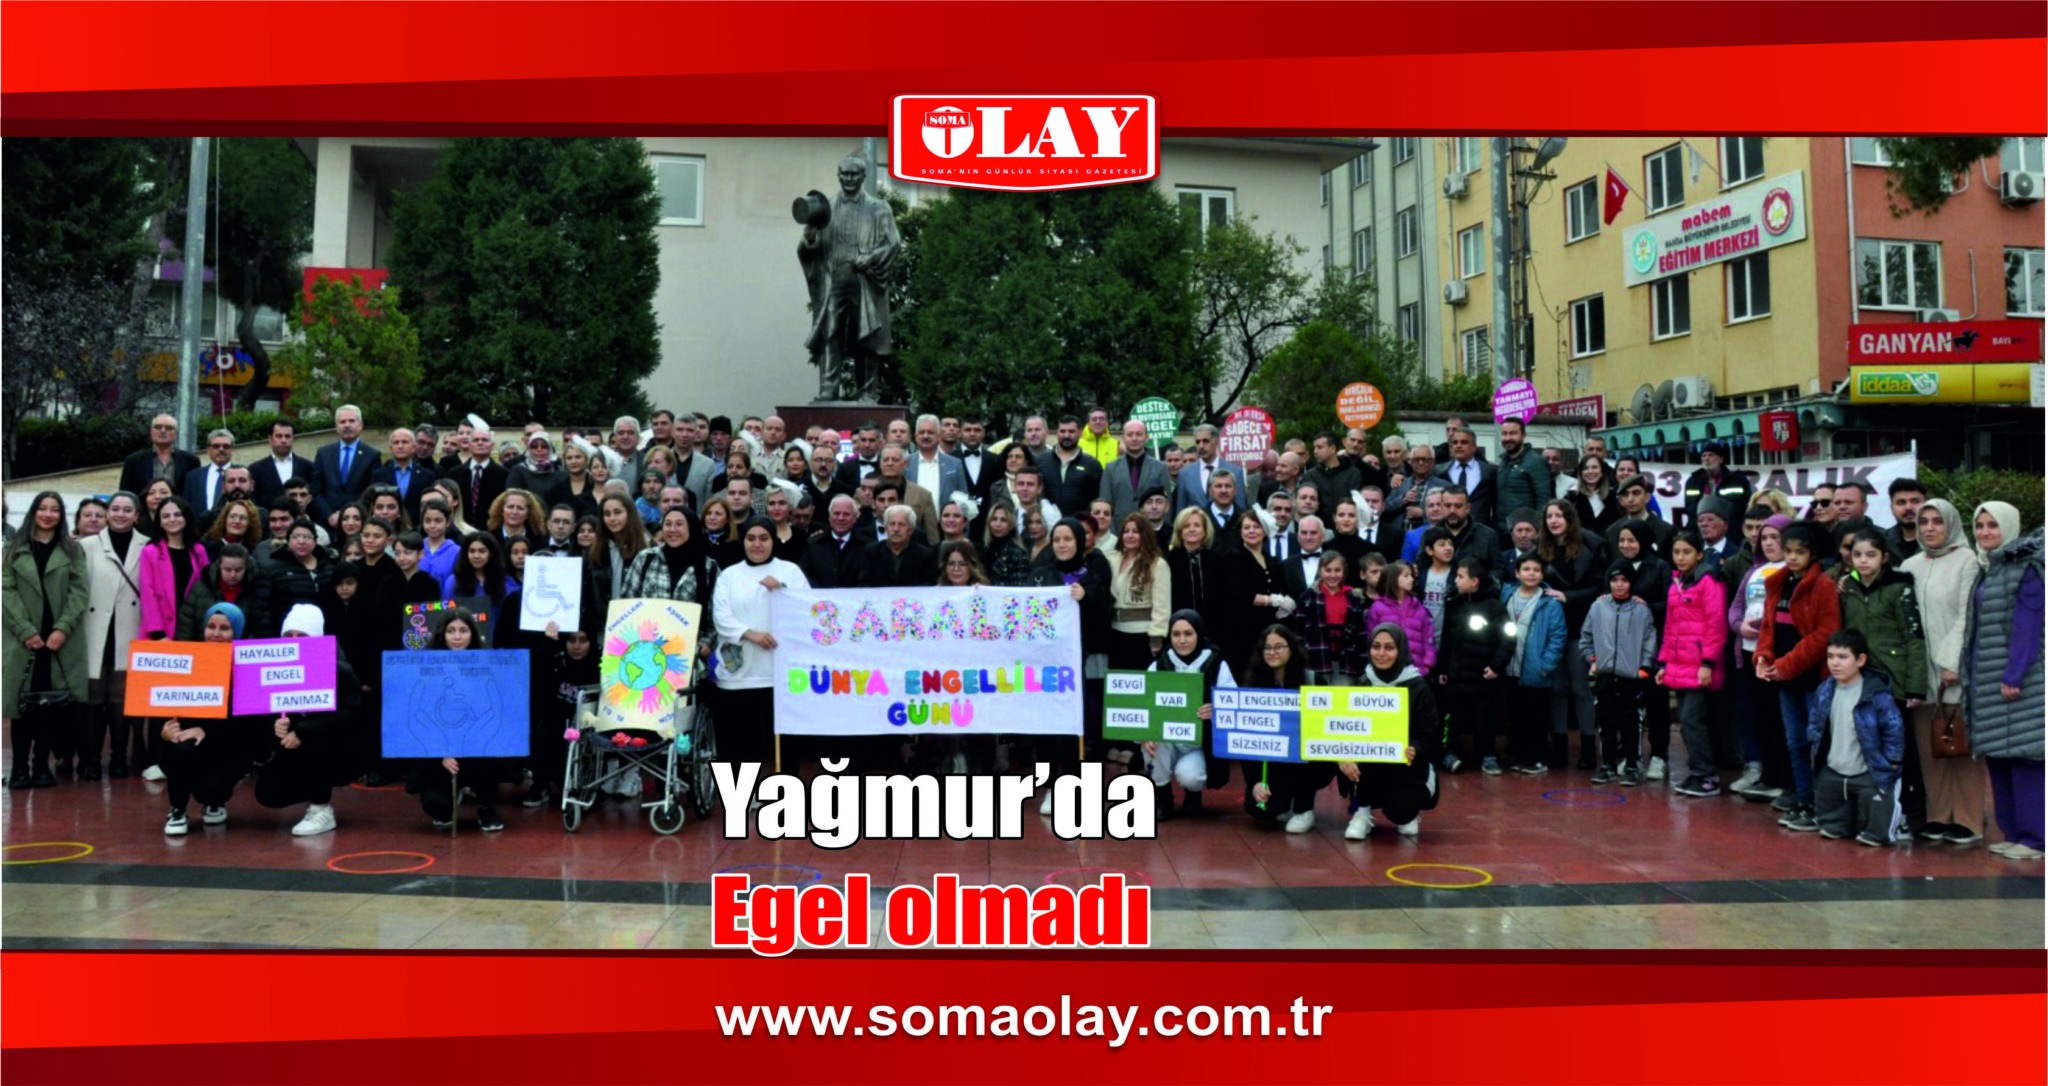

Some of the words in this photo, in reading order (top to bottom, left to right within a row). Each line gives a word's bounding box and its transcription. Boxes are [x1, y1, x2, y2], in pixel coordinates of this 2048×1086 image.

[1681, 205, 1731, 231] mabem
[1659, 245, 1701, 273] EĞİTİM
[1704, 224, 1759, 261] MERKEZİ
[1859, 332, 1952, 354] GANYAN
[1862, 376, 1911, 393] iddaa
[1136, 400, 1170, 413] DESTEK
[1226, 421, 1262, 435] SADECE
[1220, 434, 1268, 452] FIRSAT
[405, 599, 456, 616] ÇOCUKÇA
[811, 600, 842, 645] 3
[849, 595, 1059, 642] ARALIK
[239, 647, 296, 659] HAYALLER
[137, 656, 189, 670] ENGELSİZ
[266, 669, 302, 681] ENGEL
[787, 664, 889, 696] DÜNYA
[905, 659, 1075, 695] ENGELLİLER
[1111, 677, 1143, 690] SEVGİ
[156, 690, 219, 702] YARINLARA
[275, 693, 330, 706] TANIMAZ
[1160, 695, 1184, 706] VAR
[1219, 694, 1234, 705] YA
[1311, 696, 1328, 707] EN
[1353, 694, 1395, 709] BÜYÜK
[887, 699, 974, 727] GÜNÜ
[1111, 712, 1145, 723] ENGEL
[1219, 715, 1232, 725] YA
[1241, 715, 1276, 728] ENGEL
[1329, 720, 1367, 732] ENGEL
[1168, 725, 1191, 737] YOK
[1231, 737, 1282, 753] SİZSİNİZ
[1309, 742, 1396, 757] SEVGİSİZLİKTİR
